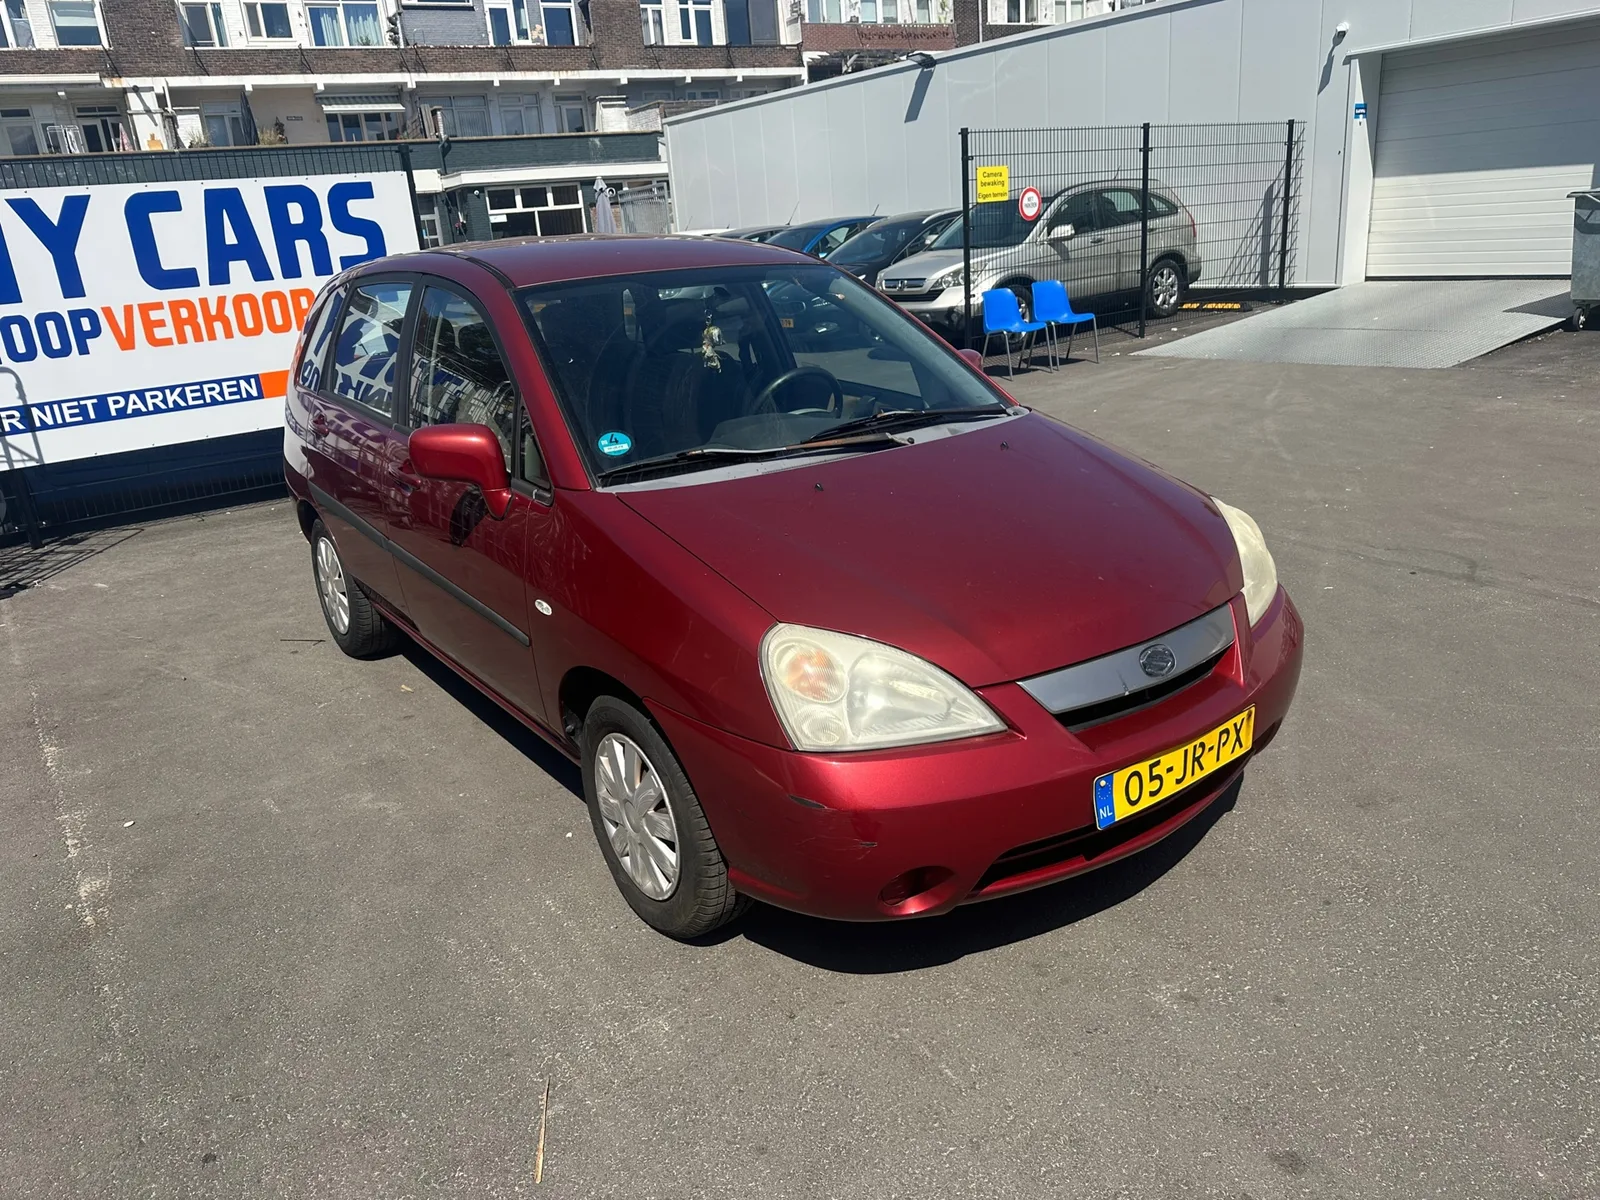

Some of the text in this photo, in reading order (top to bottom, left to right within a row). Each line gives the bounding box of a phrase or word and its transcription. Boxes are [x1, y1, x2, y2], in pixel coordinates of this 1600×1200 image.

[980, 179, 1005, 187] bewaking
[0, 181, 387, 305] Y CARS
[0, 377, 259, 432] R NIET PARKEREN
[1124, 718, 1245, 807] 05-JR-PX
[1099, 804, 1113, 820] NL
